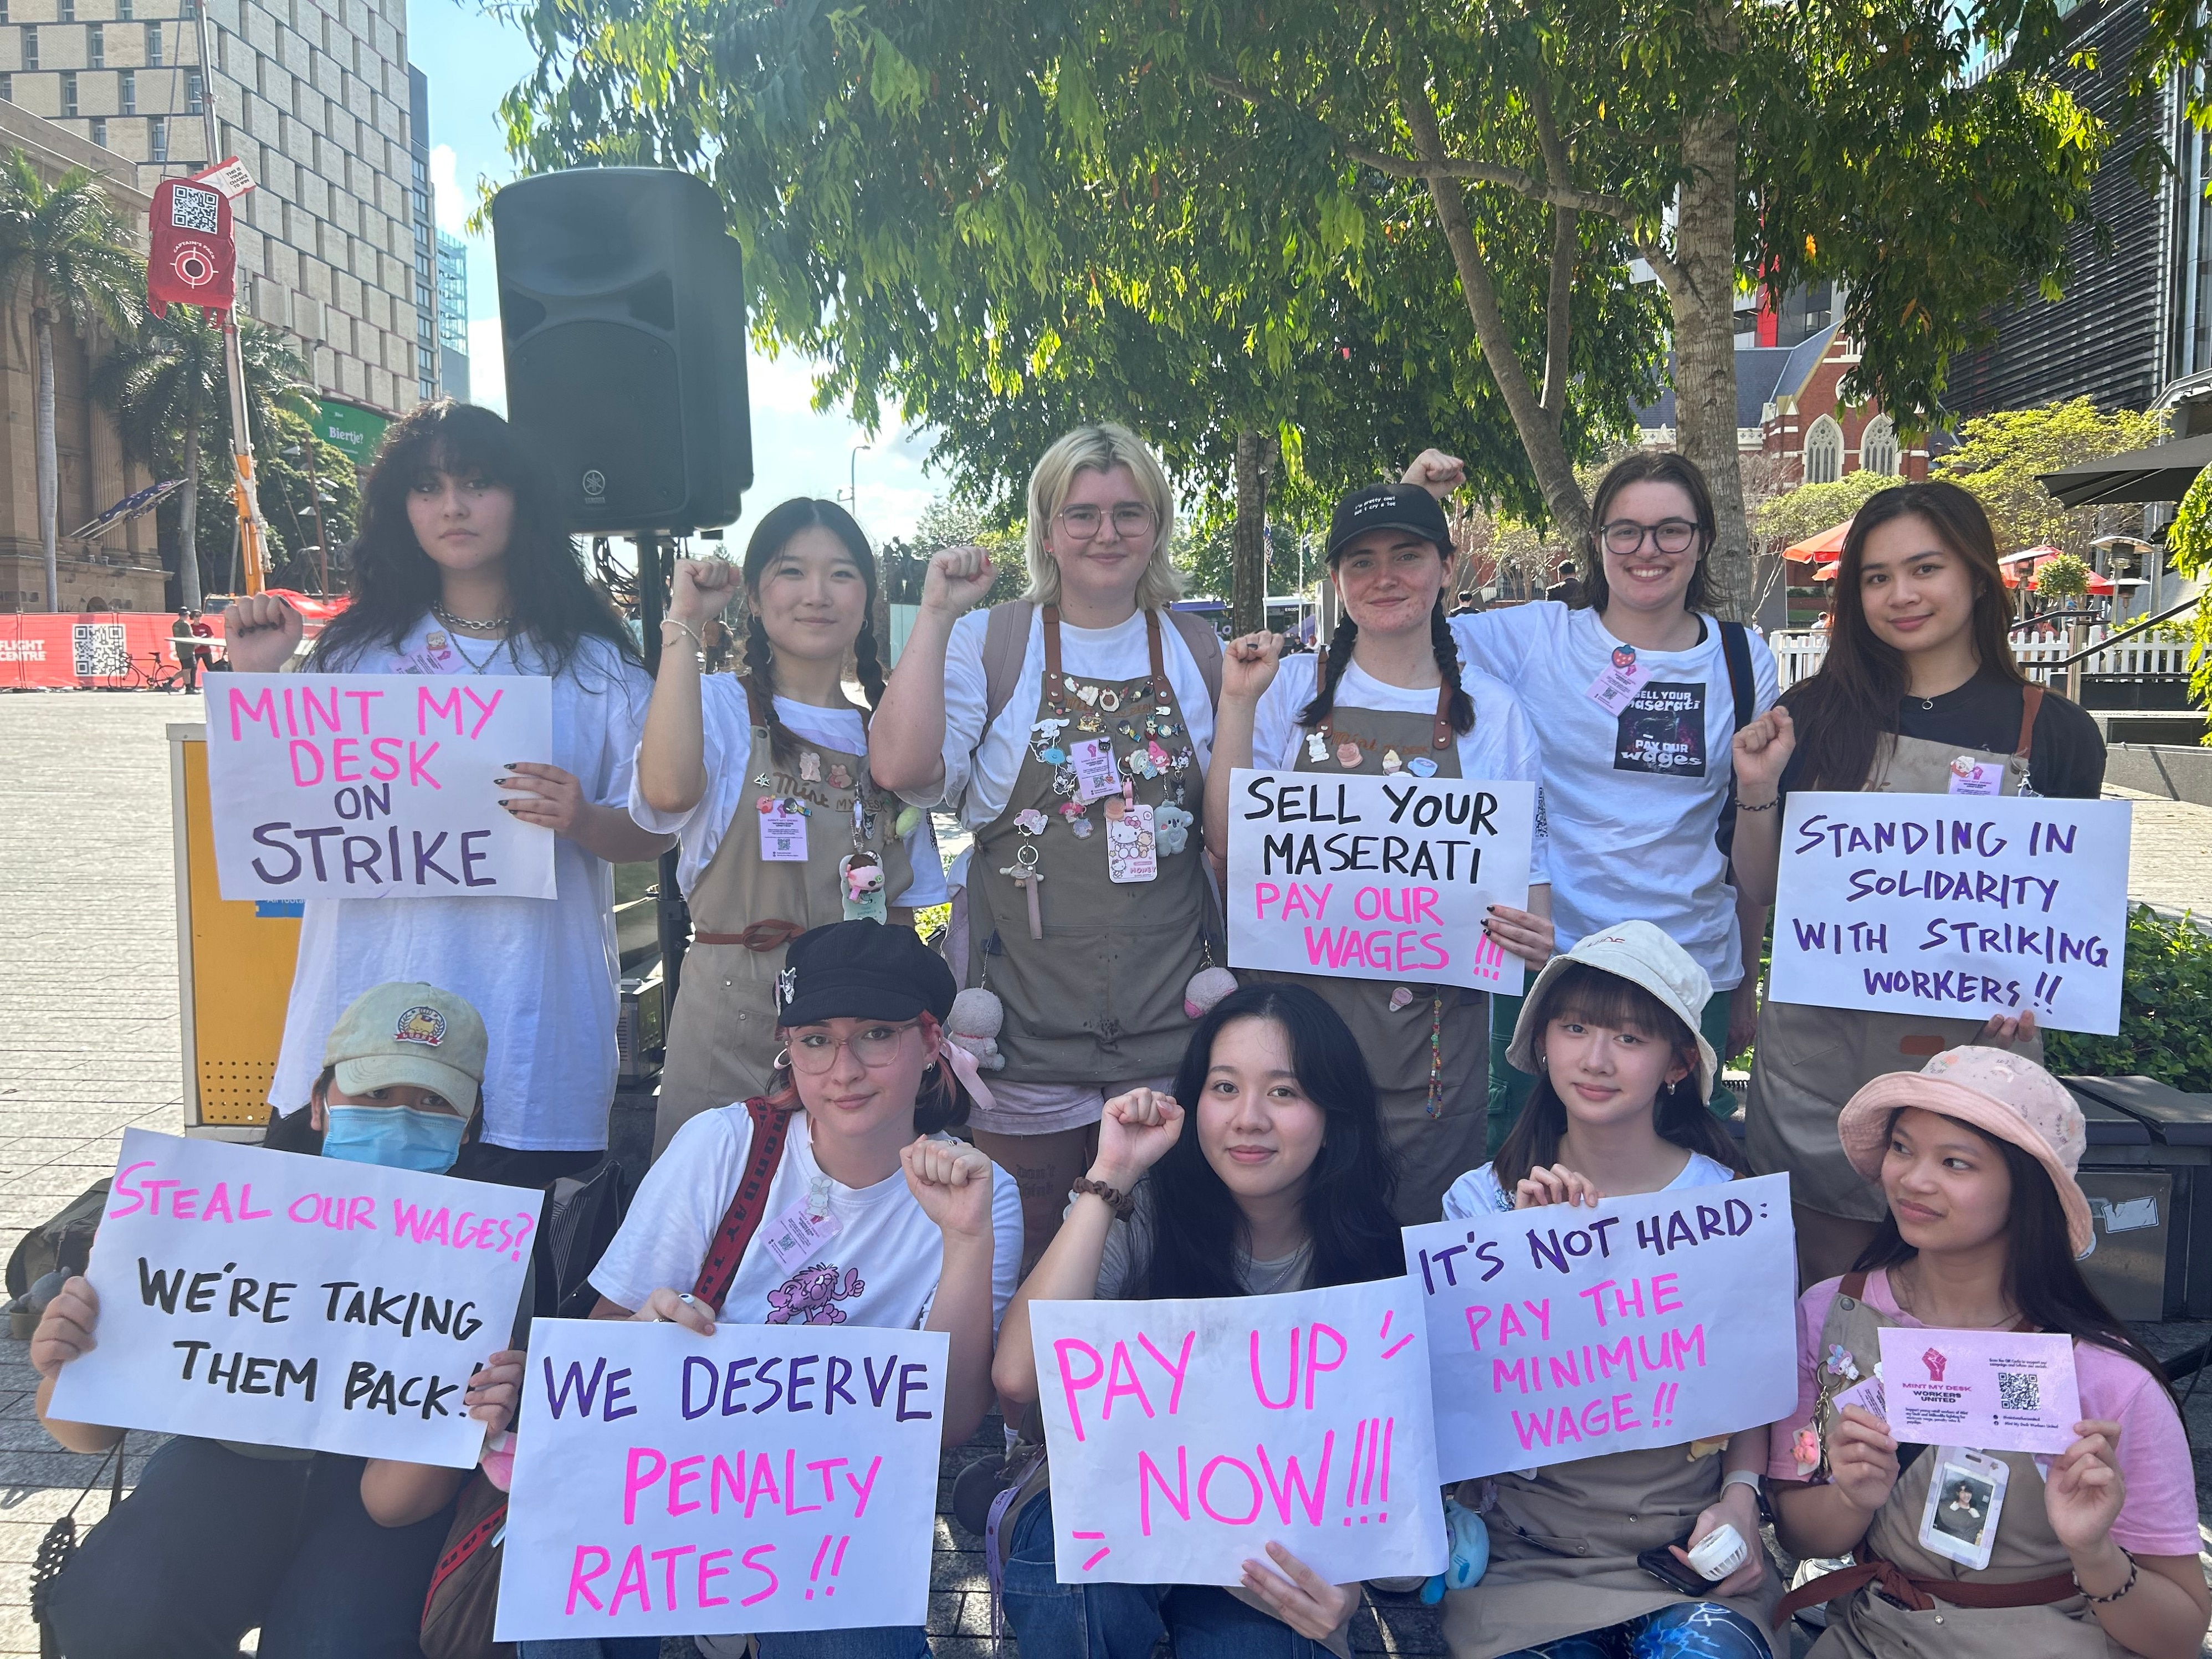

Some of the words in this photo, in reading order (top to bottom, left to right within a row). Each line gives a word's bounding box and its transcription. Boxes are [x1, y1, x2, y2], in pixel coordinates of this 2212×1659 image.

[230, 174, 248, 185] CHANCE
[173, 241, 202, 253] CAPTAIN'S
[203, 245, 216, 259] PACK
[329, 426, 363, 444] Biertje?
[0, 639, 45, 651] FLIGHT
[0, 651, 47, 662] CENTRE
[229, 686, 384, 741] MINT
[417, 685, 504, 740] MY
[1661, 692, 1692, 700] YOUR
[289, 738, 442, 790] DESK
[1621, 751, 1702, 768] wages
[1635, 739, 1660, 751] PAY
[1662, 743, 1688, 753] OUR
[334, 782, 391, 820] ON
[773, 772, 830, 808] Mint
[1244, 776, 1361, 825] SELL
[1382, 784, 1498, 836] YOUR
[252, 822, 496, 887] STRIKE
[1264, 833, 1481, 884] MASERATI
[1795, 814, 2008, 858] STANDING
[2030, 822, 2077, 857] IN
[1255, 882, 1334, 921] PAY
[1354, 886, 1445, 926] OUR
[1846, 869, 2059, 913] SOLIDARITY
[1304, 926, 1450, 972] WAGES
[1793, 918, 1888, 955] WITH
[1919, 918, 2108, 968] STRIKING
[403, 1033, 433, 1041] LUCKY
[109, 1161, 272, 1219] STEAL
[288, 1191, 377, 1231] OUR
[393, 1197, 534, 1263] WAGES?
[1419, 1231, 1504, 1296] IT'S
[1525, 1216, 1619, 1274] NOT
[1636, 1199, 1768, 1257] HARD:
[137, 1257, 298, 1324] WE'RE
[320, 1281, 483, 1341] TAKING
[1465, 1298, 1550, 1351] PAY
[1579, 1272, 1683, 1328] THE
[172, 1340, 319, 1404] THEM
[1053, 1330, 1196, 1442] PAY
[1250, 1322, 1348, 1410] UP
[1493, 1323, 1706, 1394] MINIMUM
[543, 1356, 638, 1422] WE
[682, 1355, 933, 1423] DESERVE
[623, 1447, 883, 1526] PENALTY
